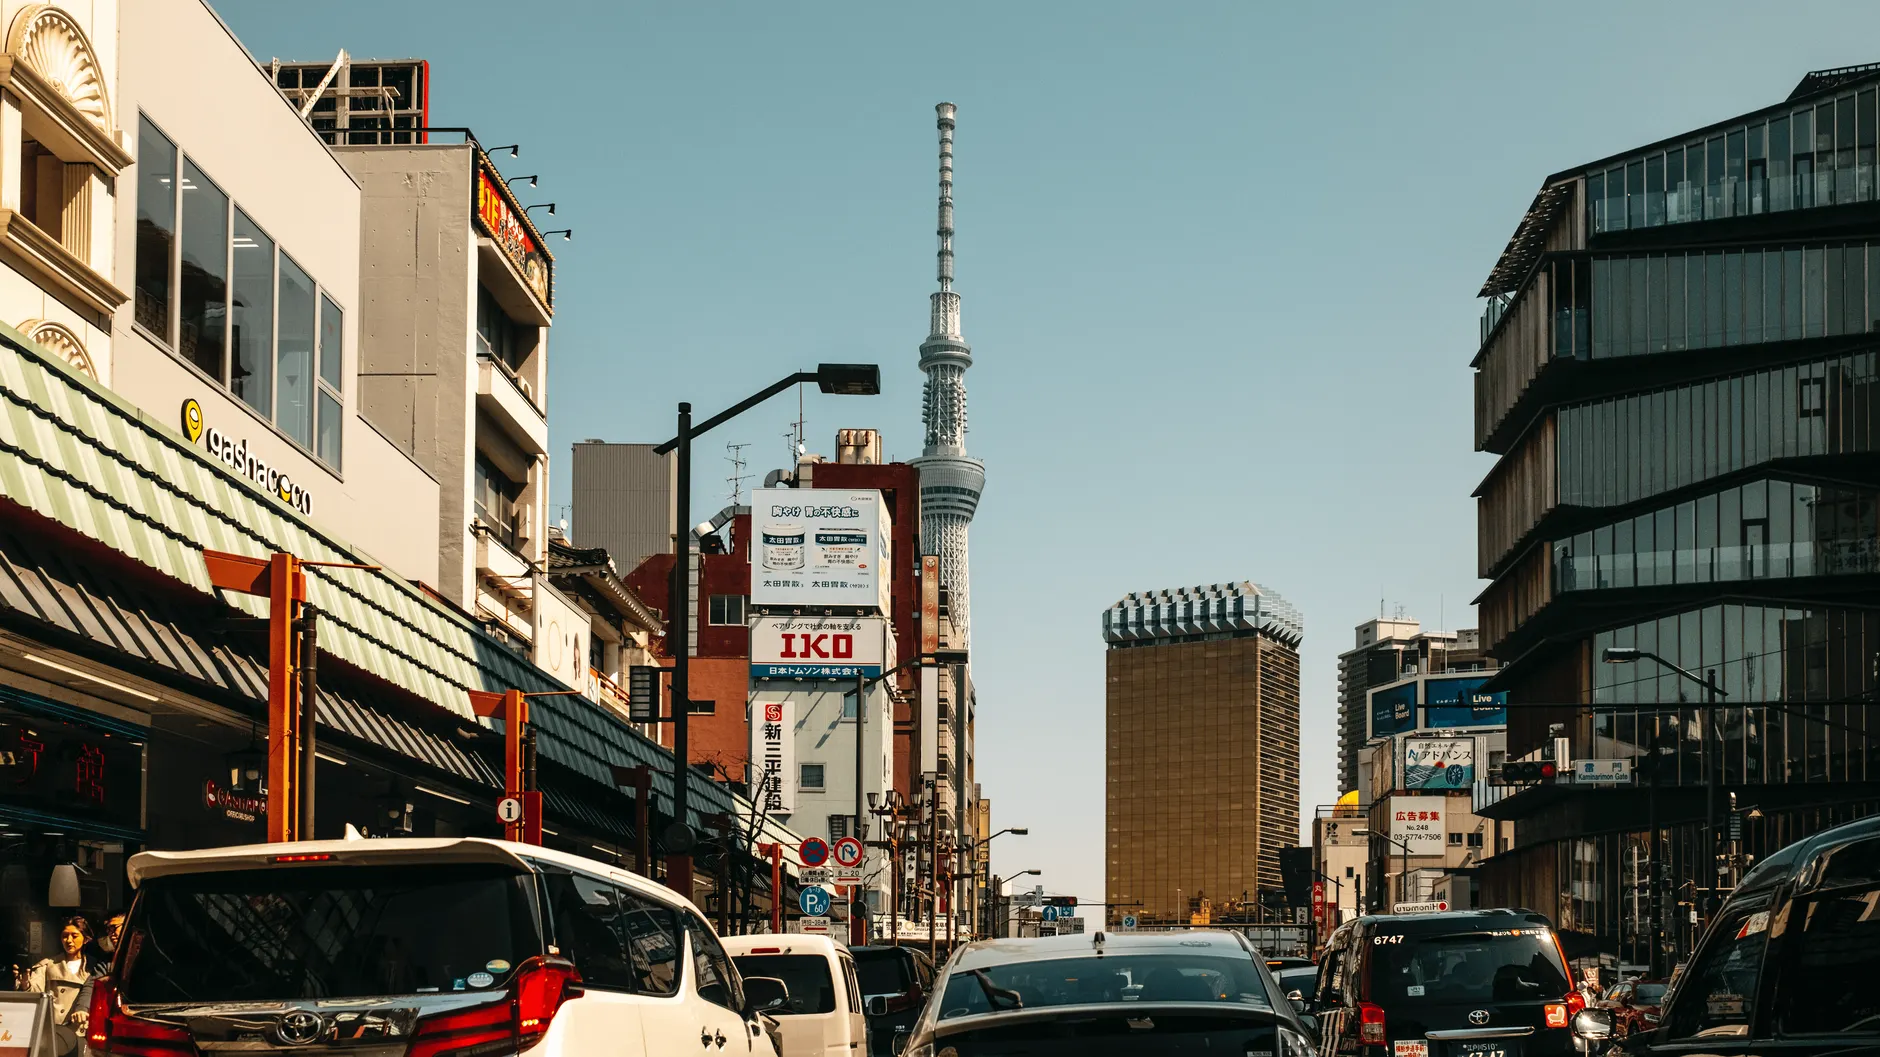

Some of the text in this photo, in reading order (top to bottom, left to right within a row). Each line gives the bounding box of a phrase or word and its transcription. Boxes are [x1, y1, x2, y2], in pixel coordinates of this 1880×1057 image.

[772, 505, 860, 518] 胸やけ 胃の不快感に
[780, 633, 853, 659] IKO
[1473, 694, 1493, 702] Live
[1396, 811, 1440, 821] 広告募集
[1393, 833, 1442, 841] 03-5774-7506
[806, 894, 818, 913] P
[1374, 935, 1404, 945] 6747
